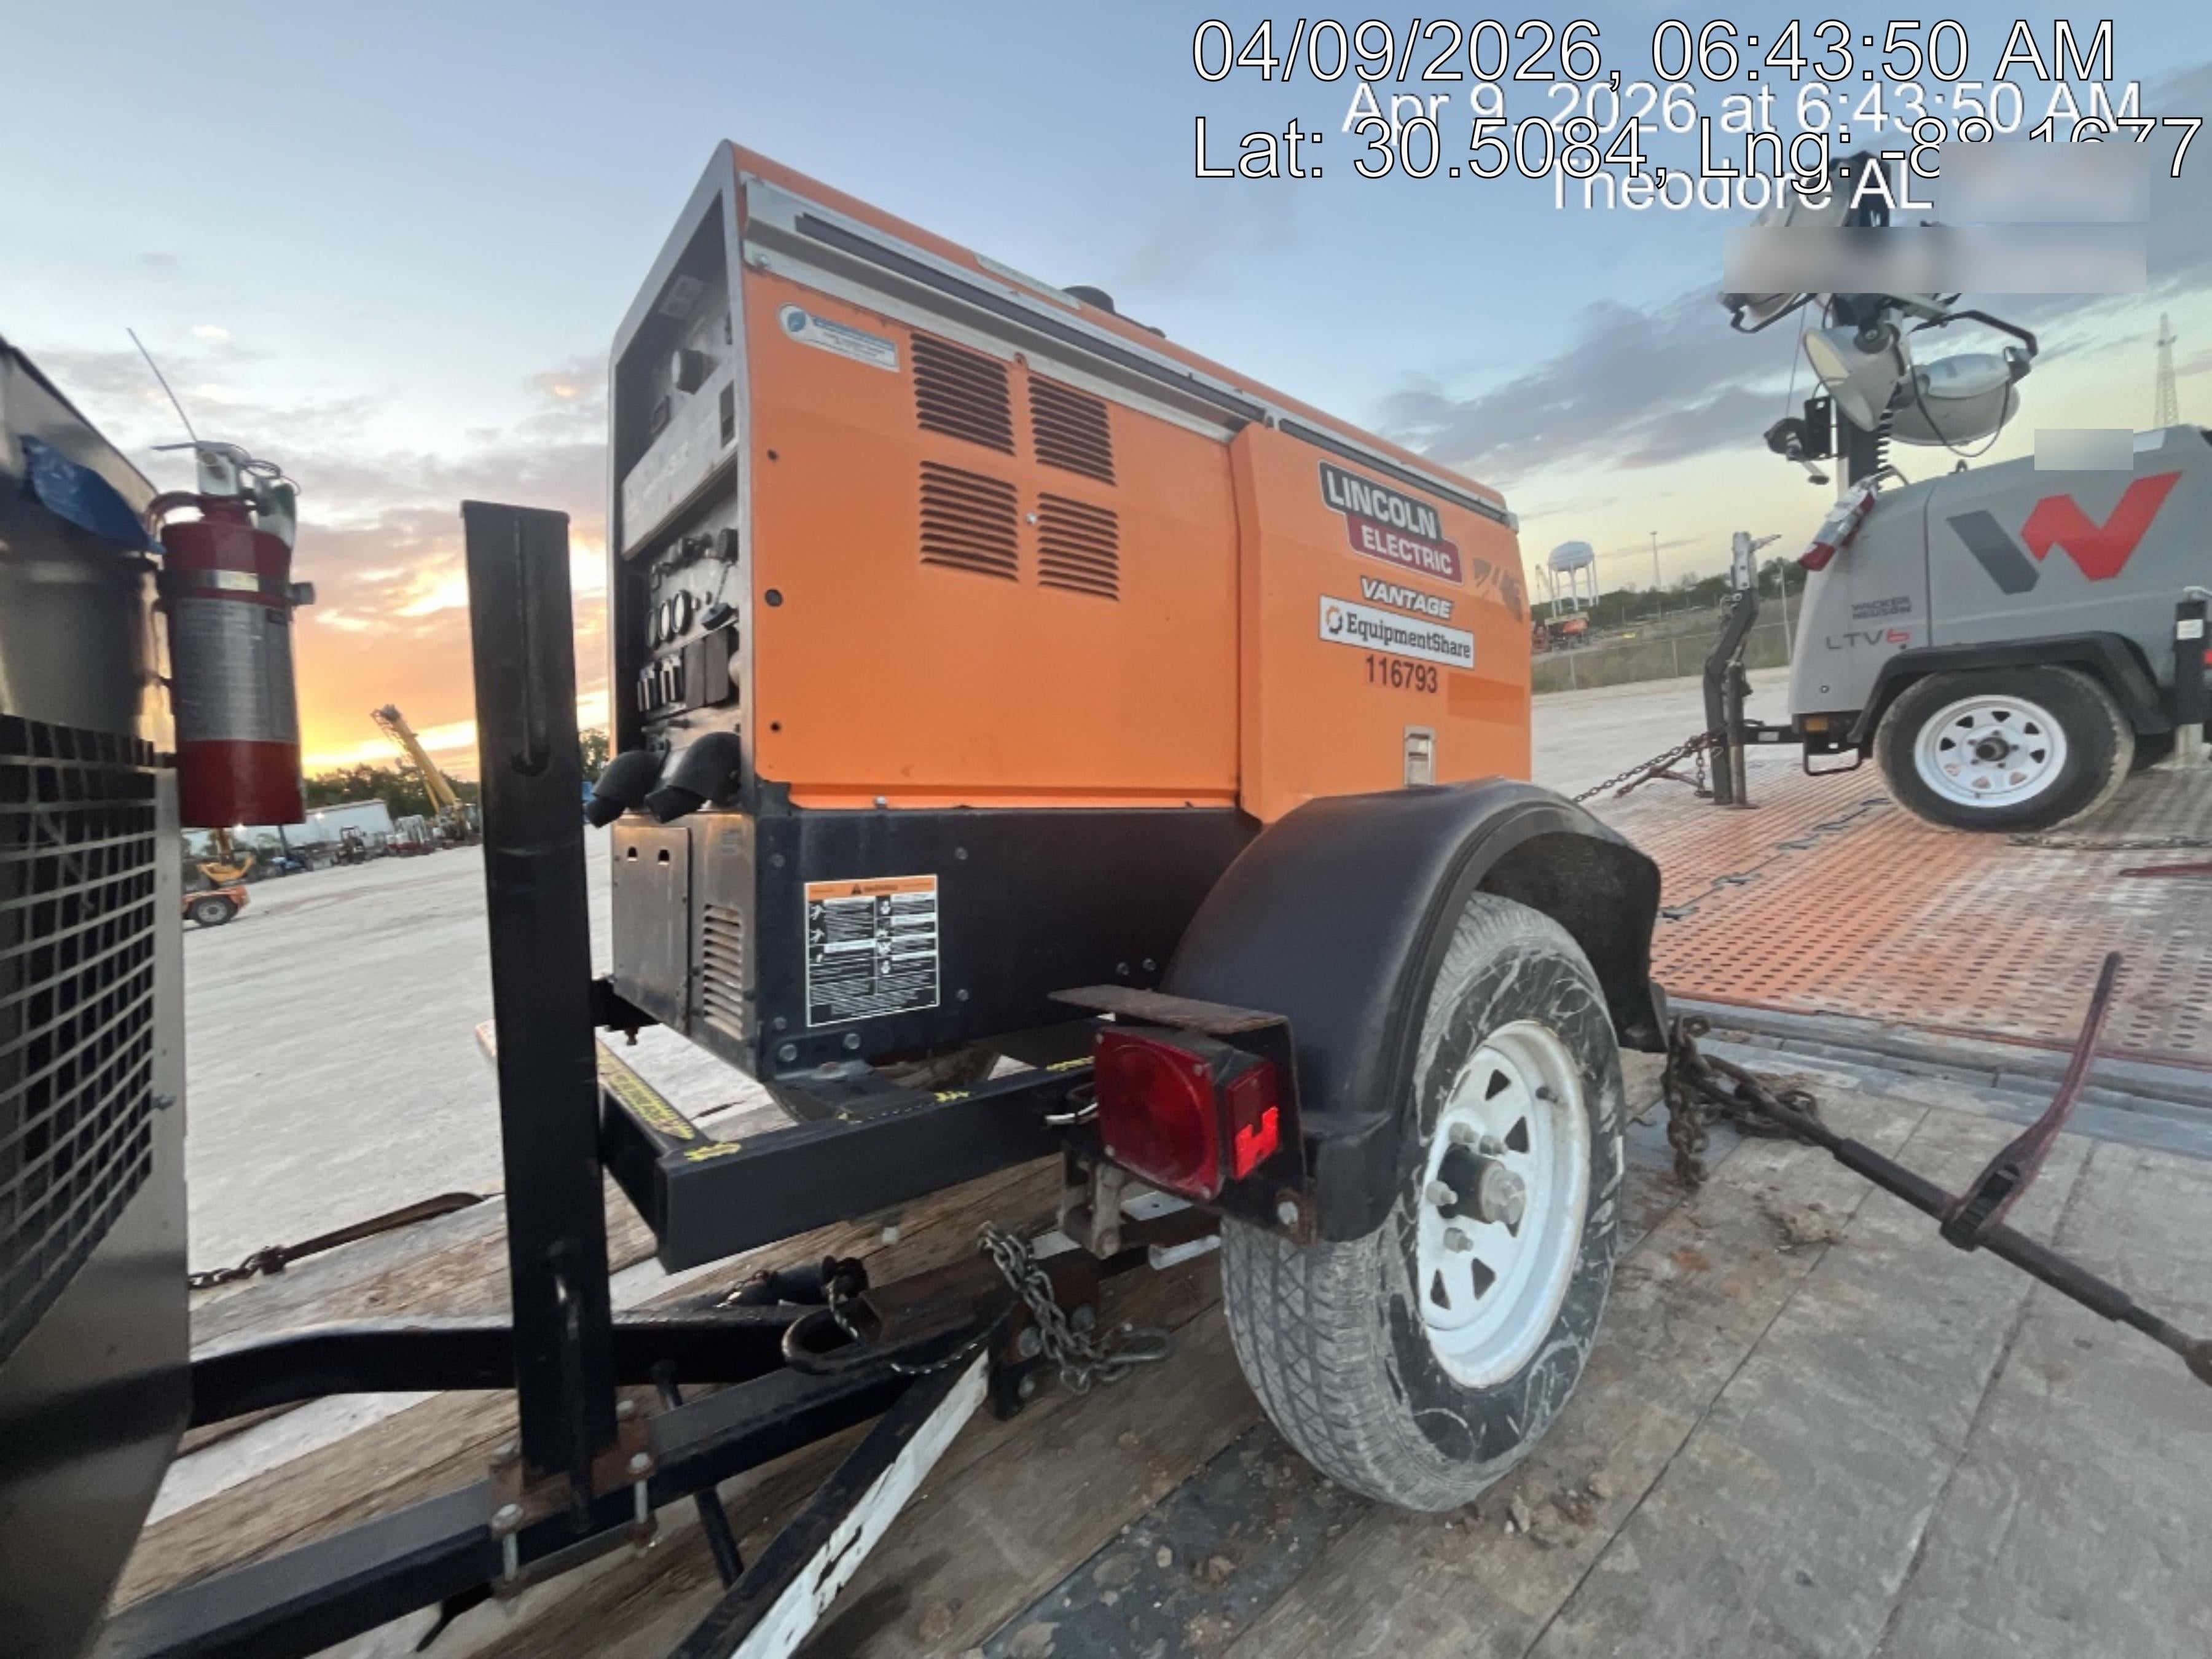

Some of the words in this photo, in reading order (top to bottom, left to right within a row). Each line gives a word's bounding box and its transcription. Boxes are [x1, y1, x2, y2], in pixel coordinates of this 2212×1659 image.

[1326, 469, 1437, 539] LINCOLN
[1360, 524, 1453, 575] ELECTRIC
[1360, 575, 1454, 621] VANTAGE
[1346, 611, 1472, 659] EquipmentShare
[1826, 627, 1910, 650] LTV6
[1365, 653, 1438, 694] 116793
